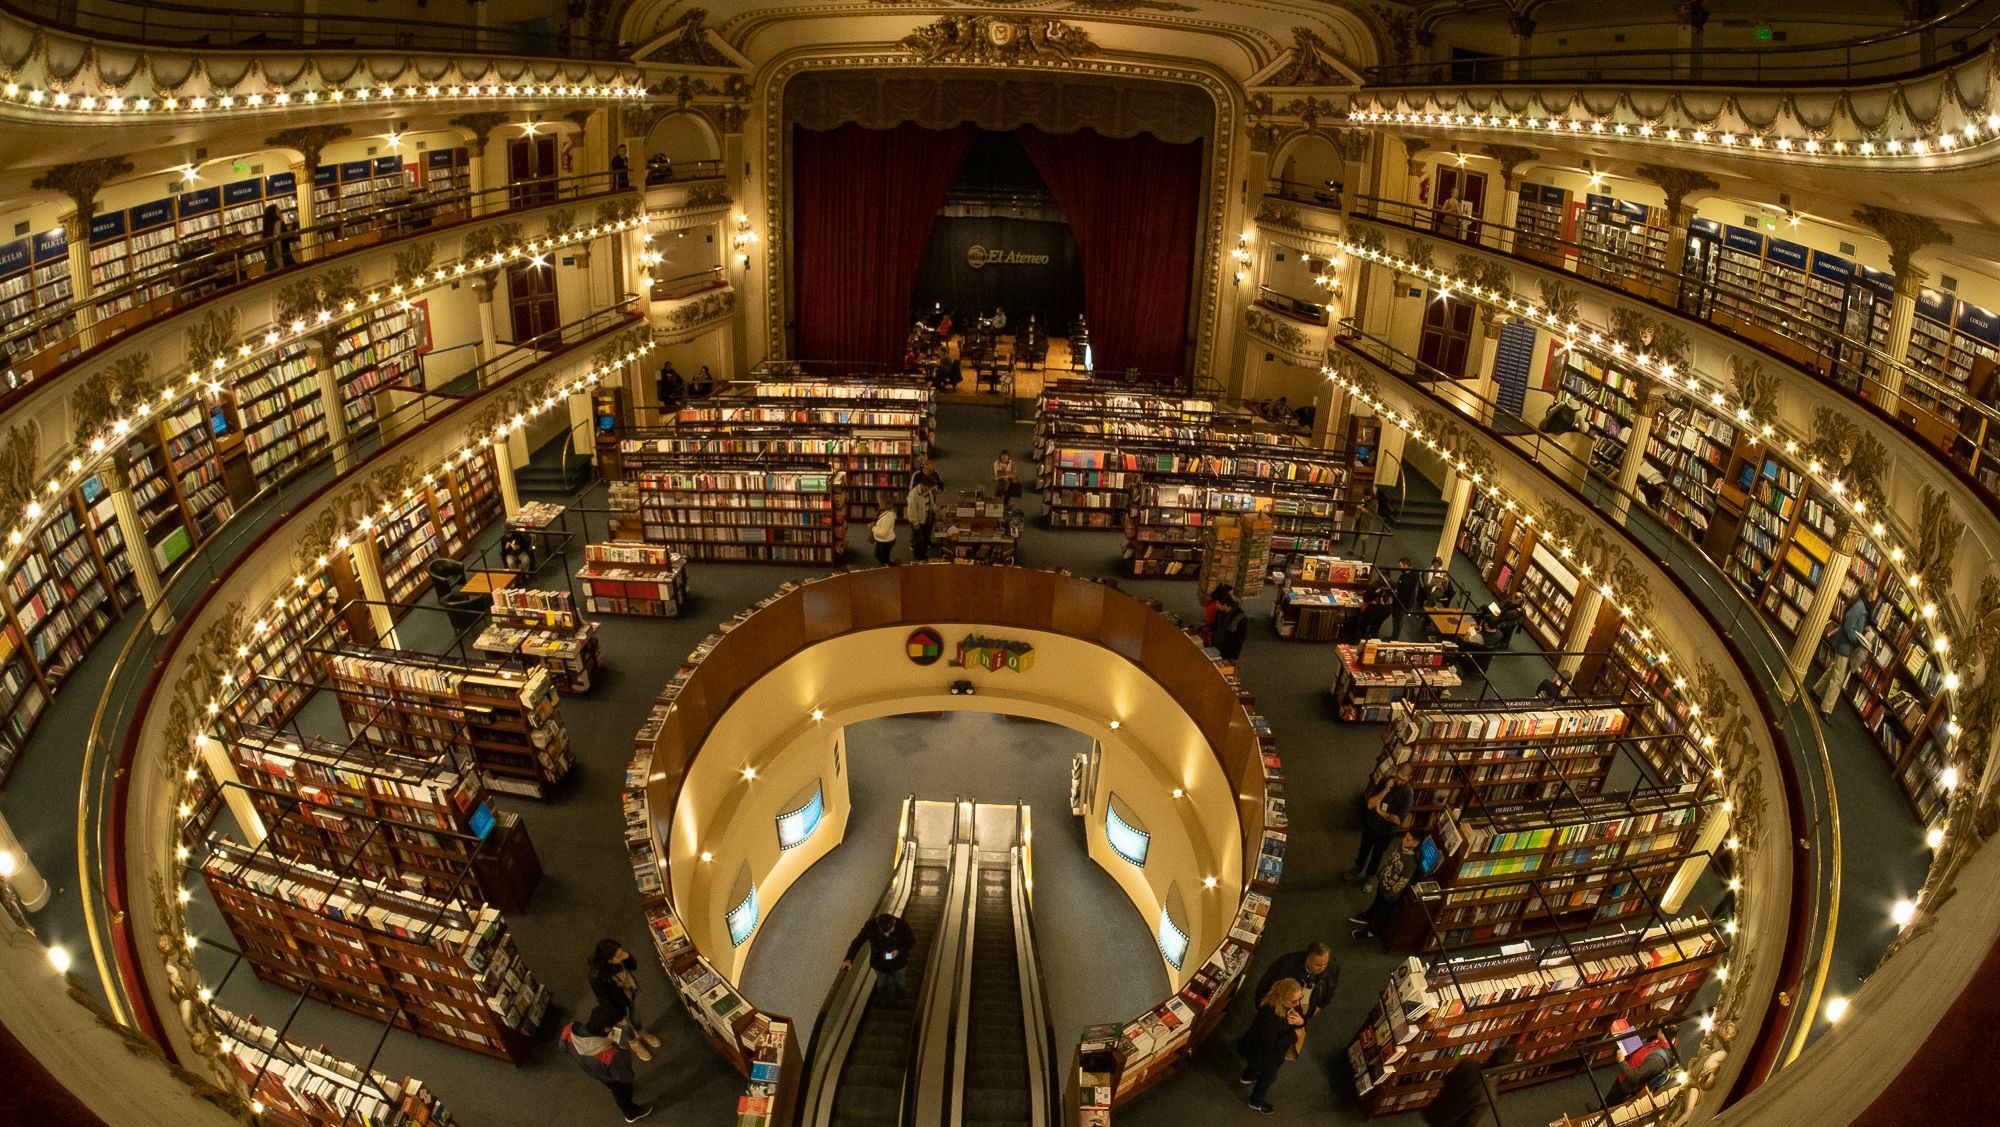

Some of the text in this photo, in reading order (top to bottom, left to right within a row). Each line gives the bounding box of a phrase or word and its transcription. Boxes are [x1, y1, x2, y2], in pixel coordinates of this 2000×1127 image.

[987, 249, 1049, 265] El Ateneo
[1472, 953, 1532, 970] INTERNACIONAL
